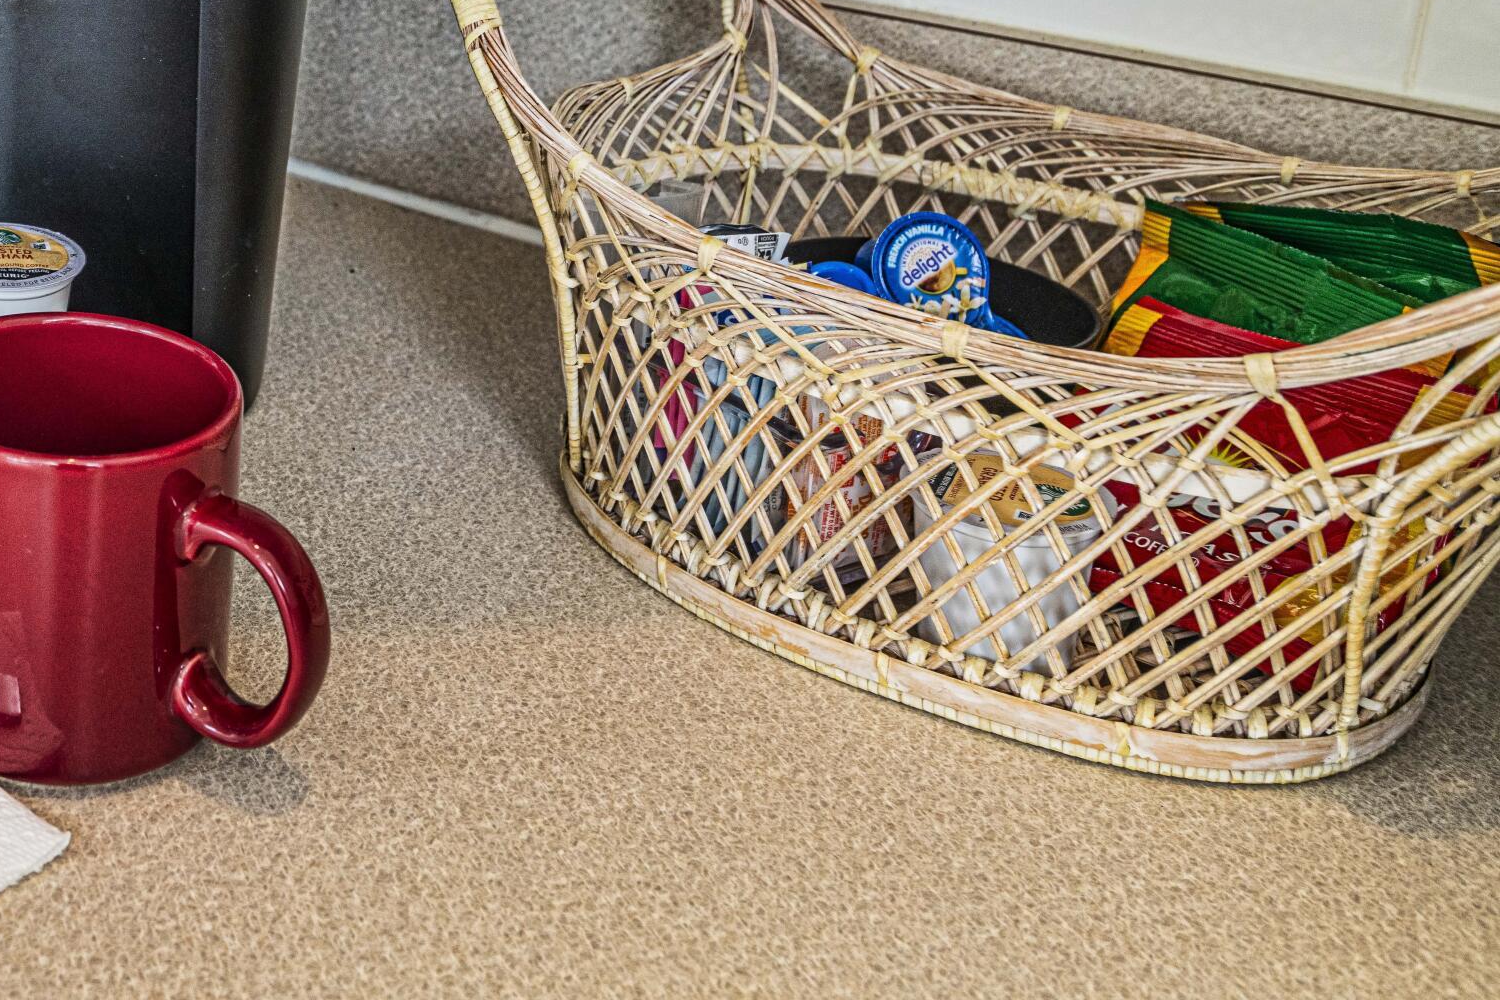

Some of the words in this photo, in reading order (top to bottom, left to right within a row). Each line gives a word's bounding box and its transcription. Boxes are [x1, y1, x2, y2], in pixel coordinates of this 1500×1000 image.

[887, 233, 908, 269] FRENCH
[905, 224, 945, 238] VANILLA
[901, 244, 955, 287] delight
